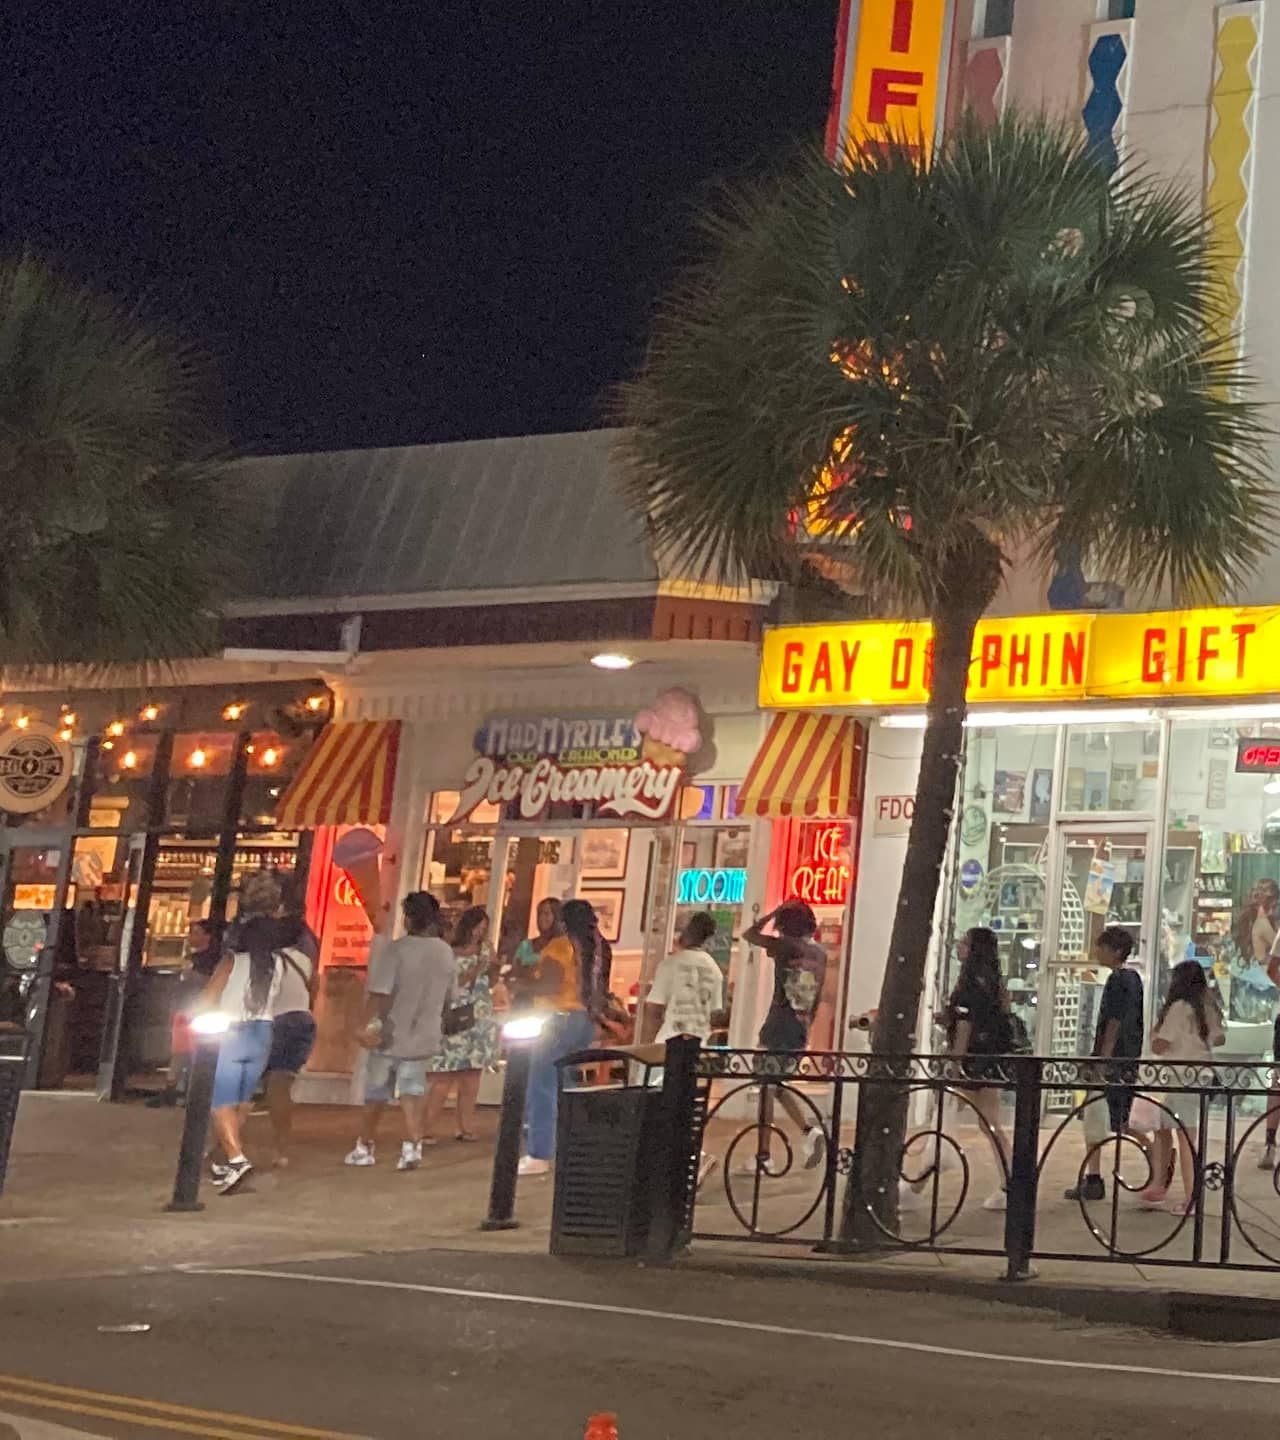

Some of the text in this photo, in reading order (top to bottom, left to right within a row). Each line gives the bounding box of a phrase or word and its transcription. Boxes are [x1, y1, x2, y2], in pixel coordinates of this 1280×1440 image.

[781, 641, 861, 693] GAY
[890, 630, 1087, 691] DPHIN
[1141, 623, 1256, 683] GIFT
[450, 757, 682, 821] Ice Creamery
[813, 826, 843, 862] ICE
